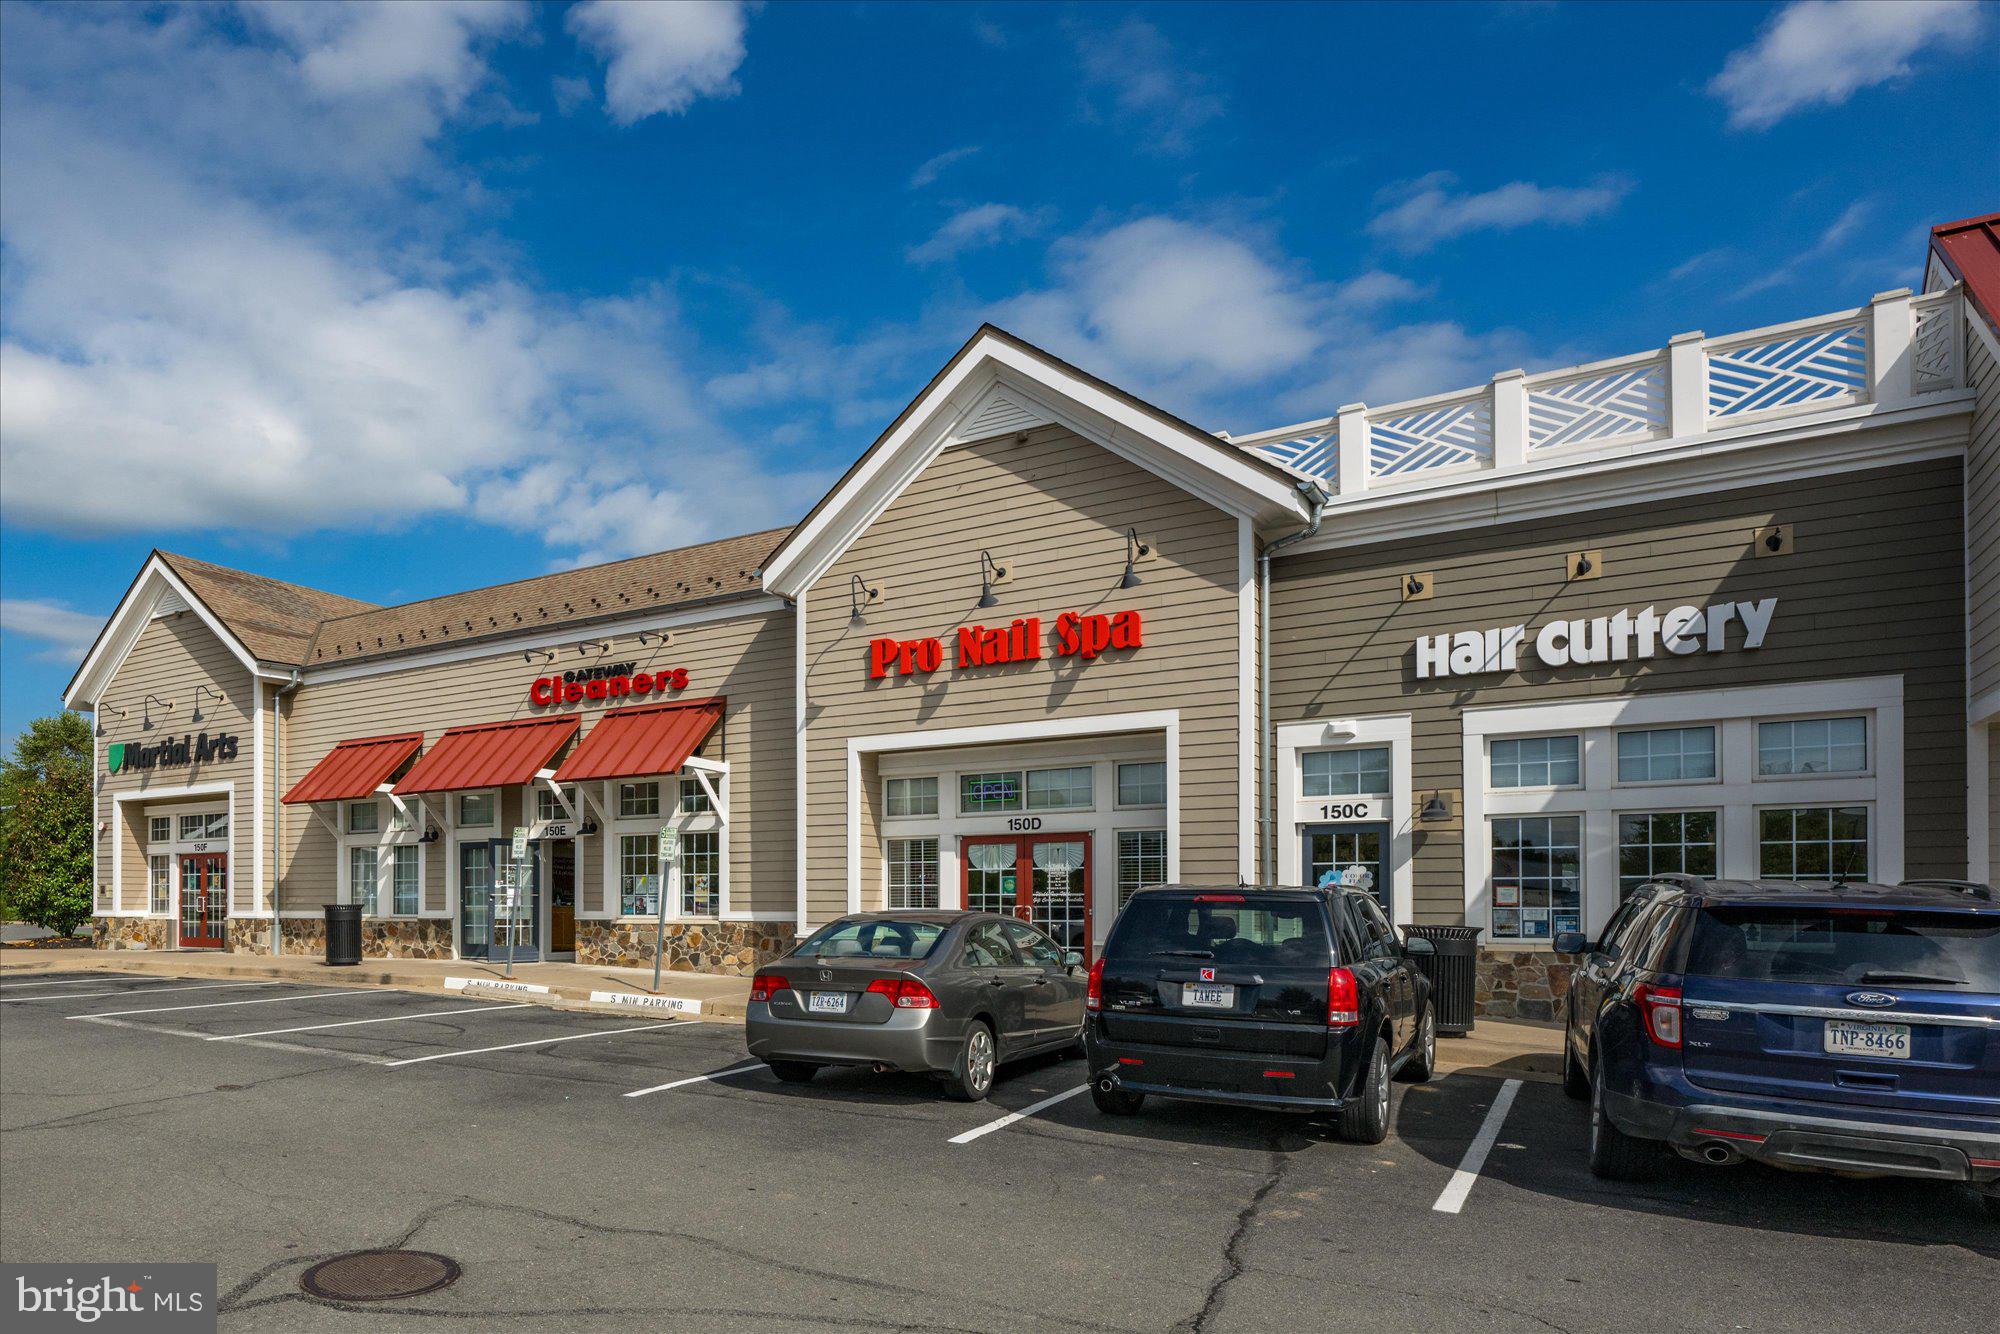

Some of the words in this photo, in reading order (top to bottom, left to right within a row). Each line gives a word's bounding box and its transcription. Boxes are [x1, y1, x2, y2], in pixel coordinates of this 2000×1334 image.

[869, 637, 943, 679] Pro
[957, 617, 1042, 668] Nail
[1055, 610, 1143, 660] Spa
[1416, 623, 1525, 679] Hair
[563, 661, 638, 683] GATEWAY
[530, 667, 689, 706] Cleaners
[122, 734, 191, 771] Martial
[194, 732, 239, 763] Arts
[973, 783, 1013, 800] OPEN
[1320, 803, 1368, 820] 150C
[544, 825, 566, 836] 150E
[1007, 817, 1042, 831] 150D
[193, 842, 208, 852] 150F
[621, 995, 639, 1006] MIN
[642, 997, 683, 1010] PARKING
[1857, 993, 1885, 1004] Ford
[1847, 1023, 1888, 1033] VIRGINIA
[1688, 1040, 1712, 1048] XLT
[1830, 1029, 1905, 1050] TNP-8466
